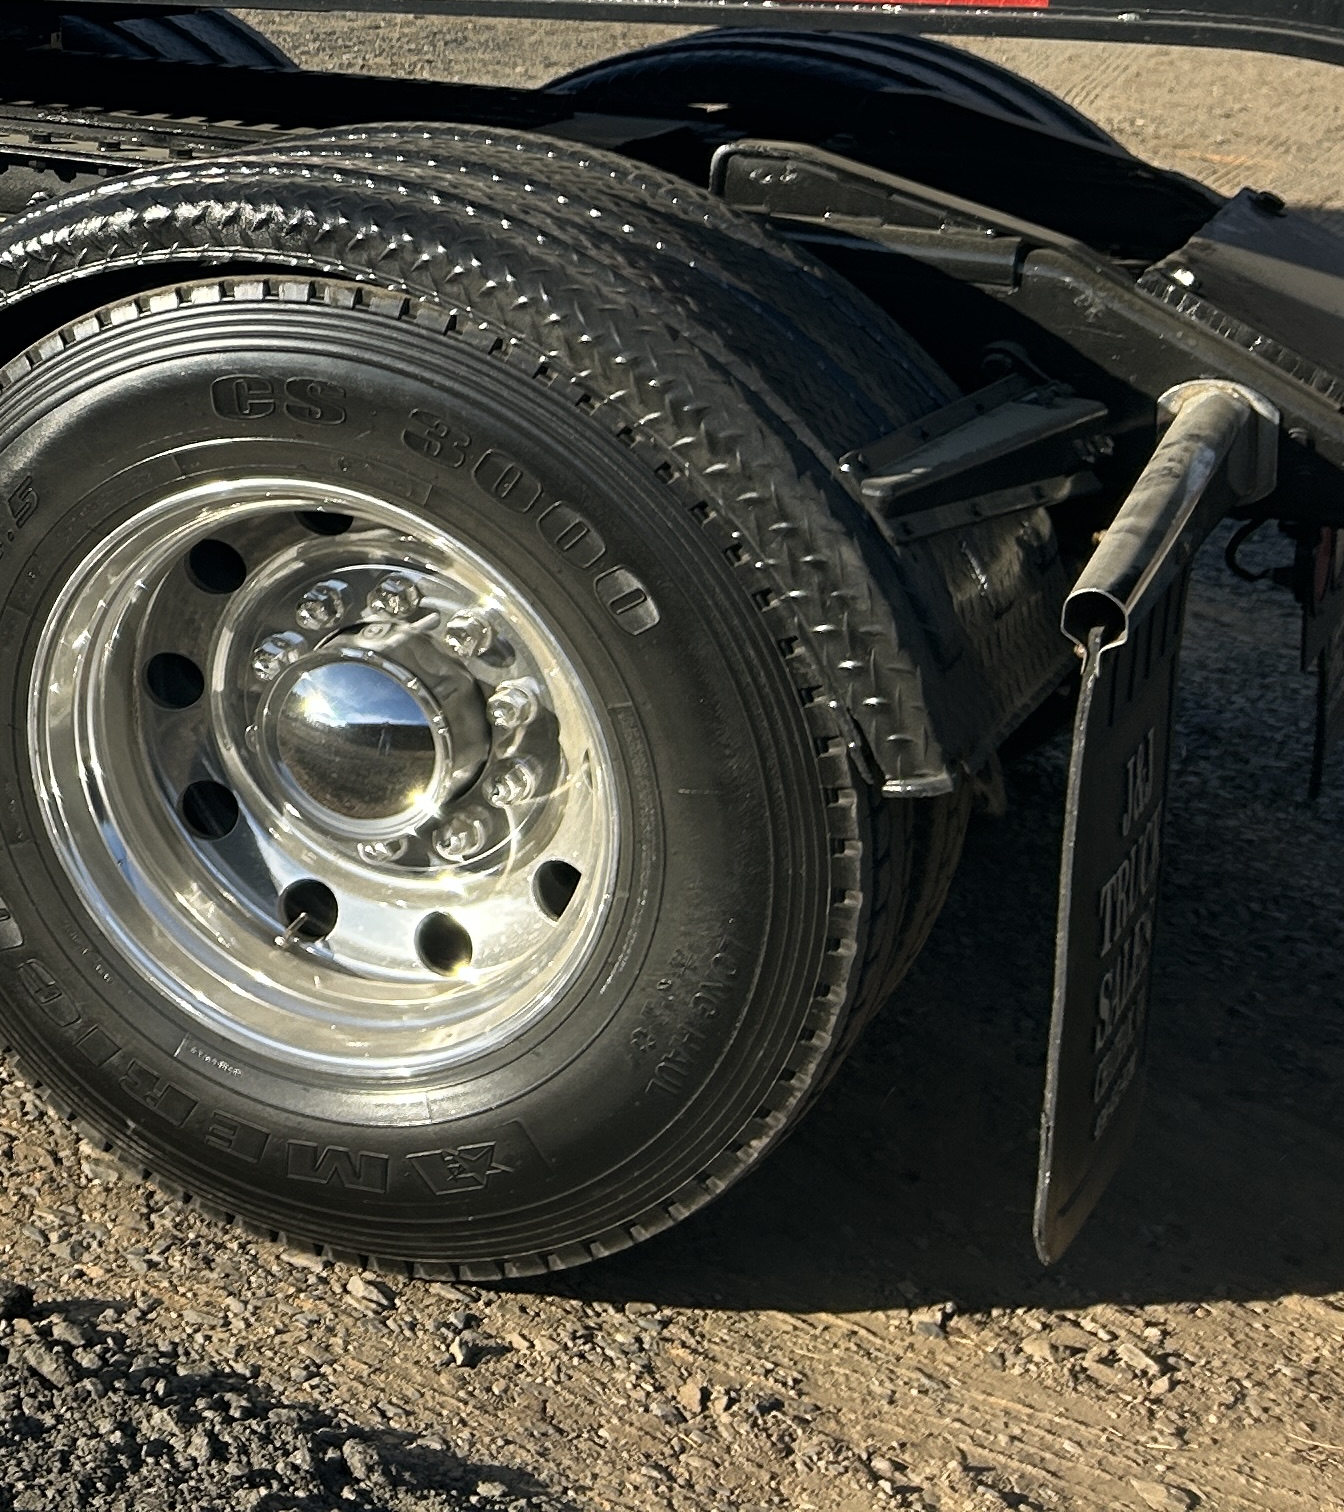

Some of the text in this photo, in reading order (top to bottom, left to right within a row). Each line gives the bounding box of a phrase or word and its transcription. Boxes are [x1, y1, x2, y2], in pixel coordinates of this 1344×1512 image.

[211, 374, 661, 636] CS 3000
[643, 1021, 706, 1095] HAUL
